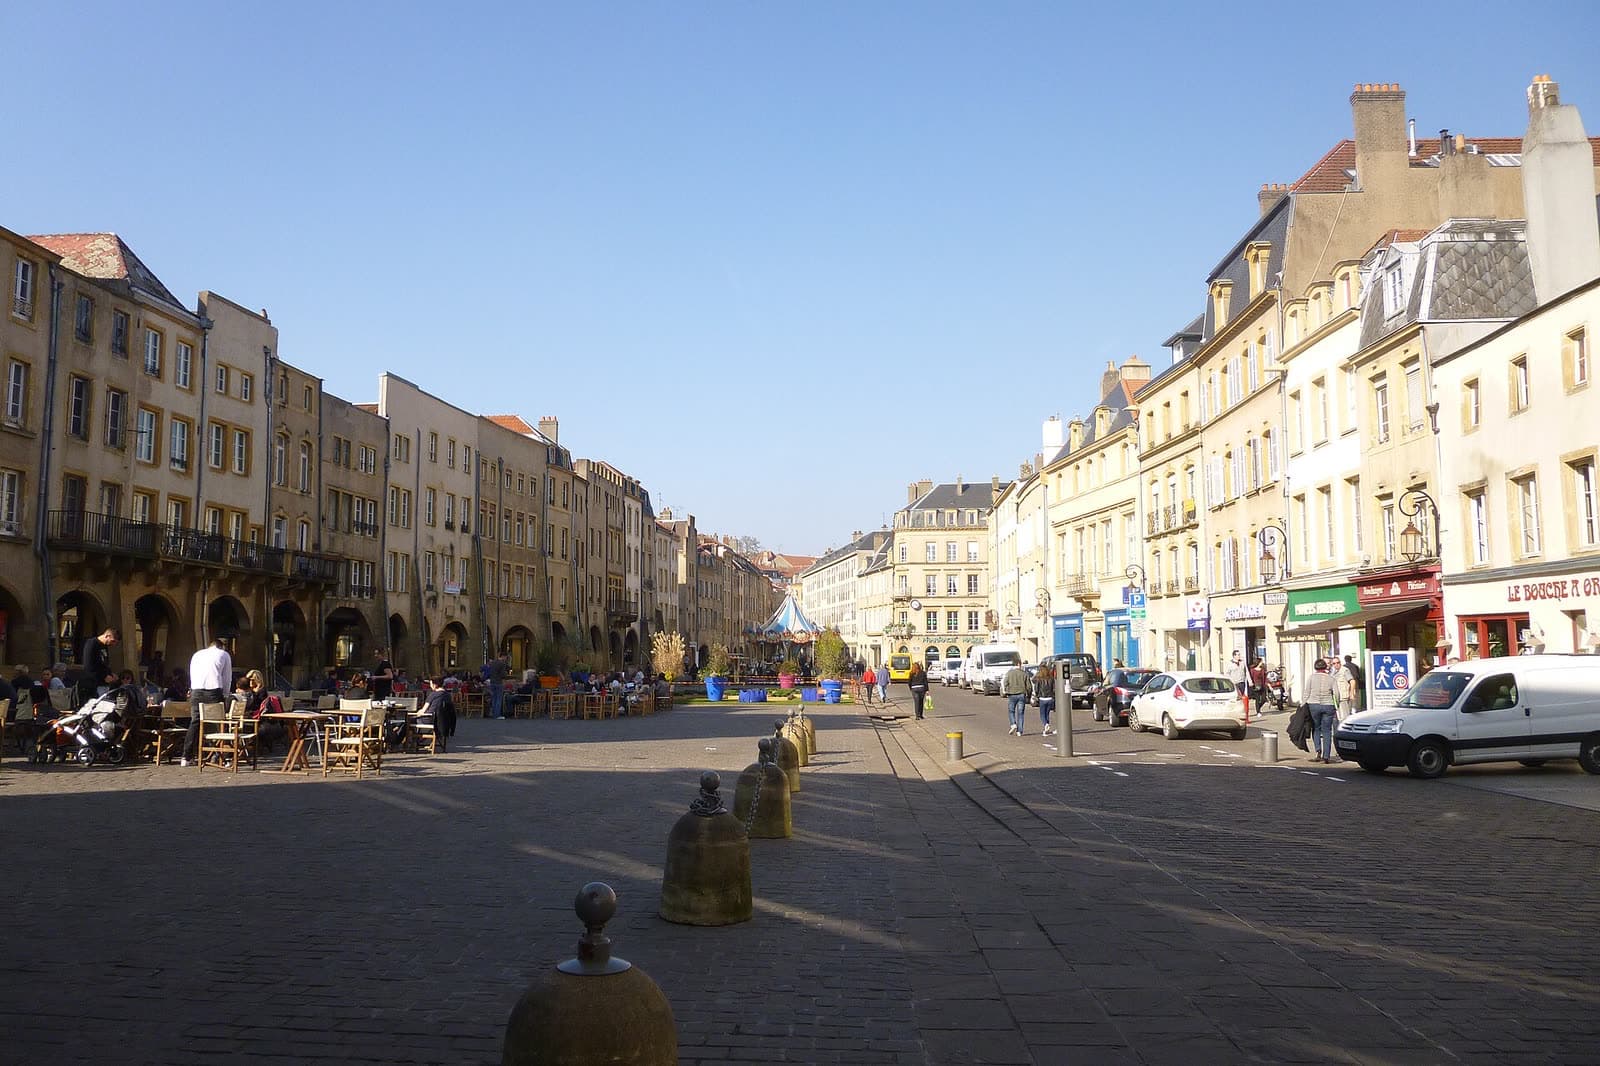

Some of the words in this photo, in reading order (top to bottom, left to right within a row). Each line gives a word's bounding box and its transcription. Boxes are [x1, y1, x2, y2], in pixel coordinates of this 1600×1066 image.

[1508, 585, 1521, 602] LE
[1523, 580, 1568, 601] BOUCHE
[1133, 595, 1141, 605] P
